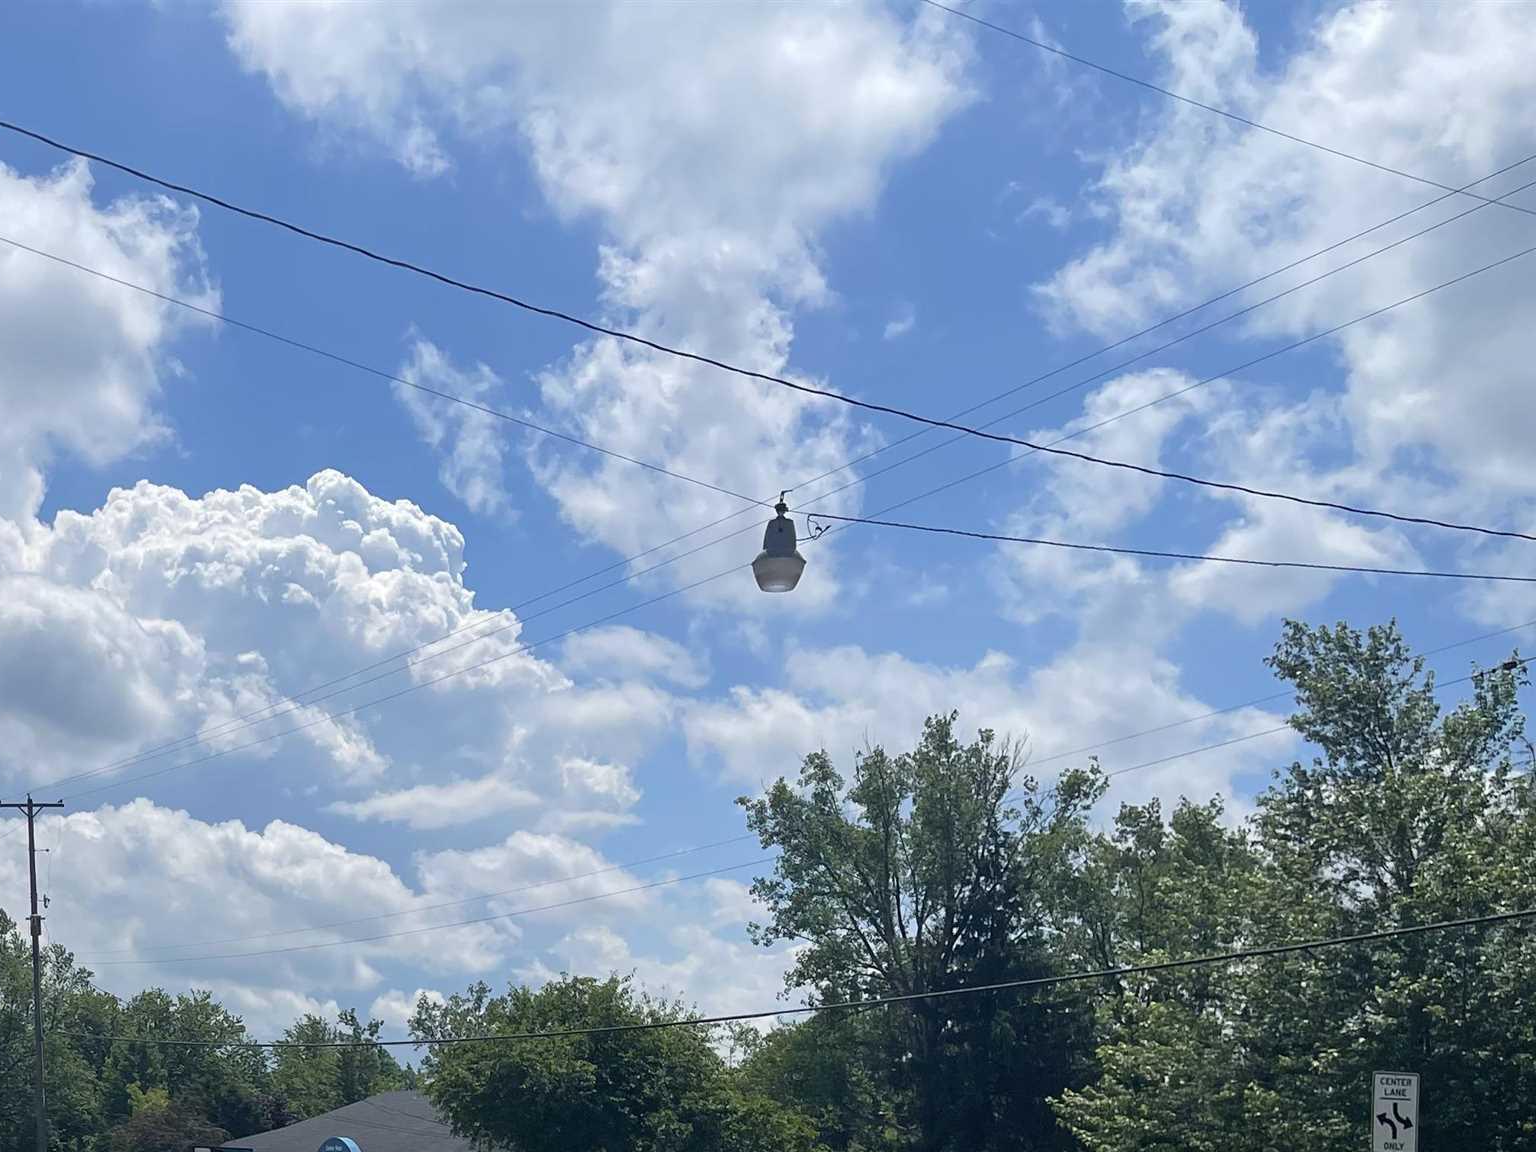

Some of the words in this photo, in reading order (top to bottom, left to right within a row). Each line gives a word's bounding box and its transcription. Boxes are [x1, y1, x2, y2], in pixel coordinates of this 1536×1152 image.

[1380, 1078, 1412, 1087] CENTER
[1384, 1088, 1407, 1097] LANE
[1383, 1142, 1405, 1151] ONLY
